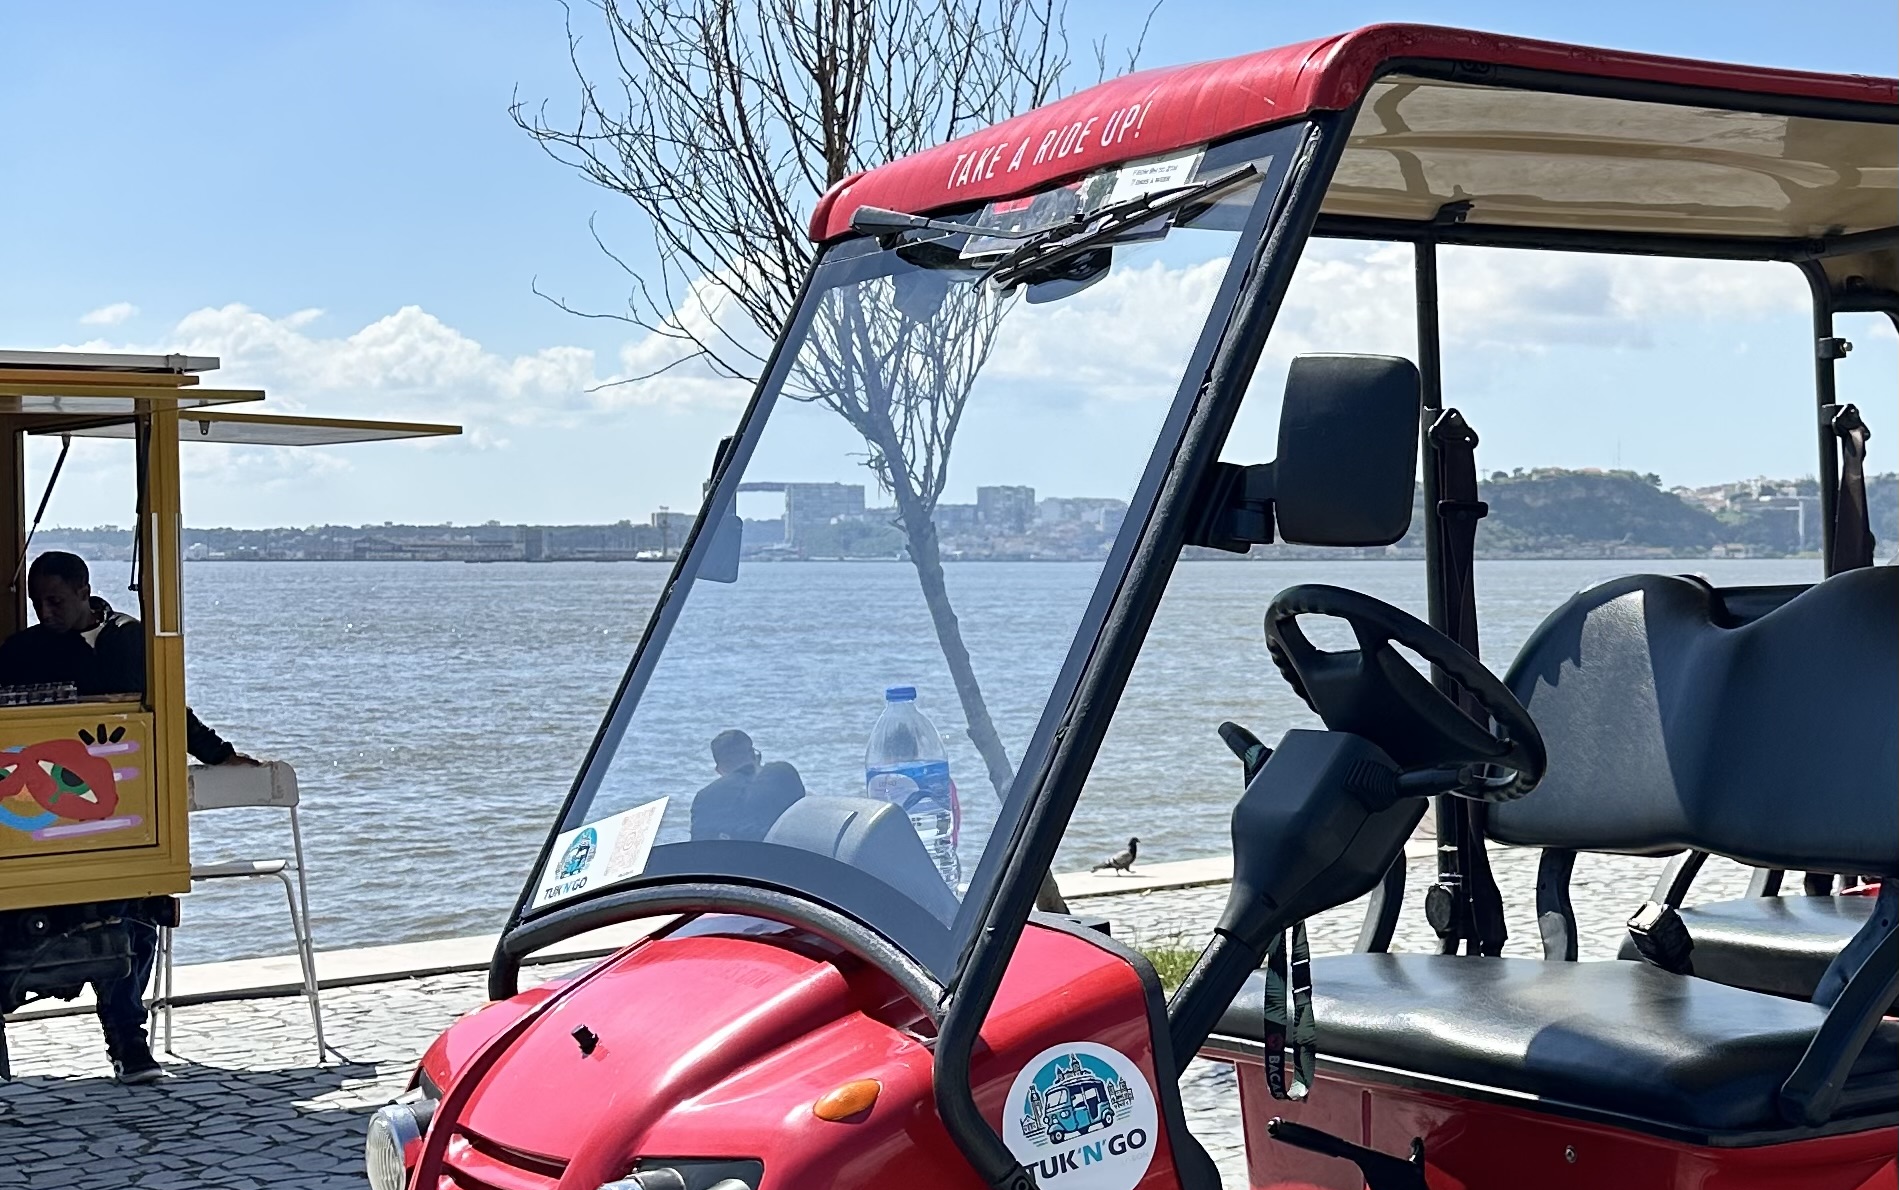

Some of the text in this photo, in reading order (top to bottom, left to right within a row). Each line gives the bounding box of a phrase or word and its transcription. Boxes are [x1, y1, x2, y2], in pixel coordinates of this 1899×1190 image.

[947, 100, 1154, 189] TAKE A RIDE UP!
